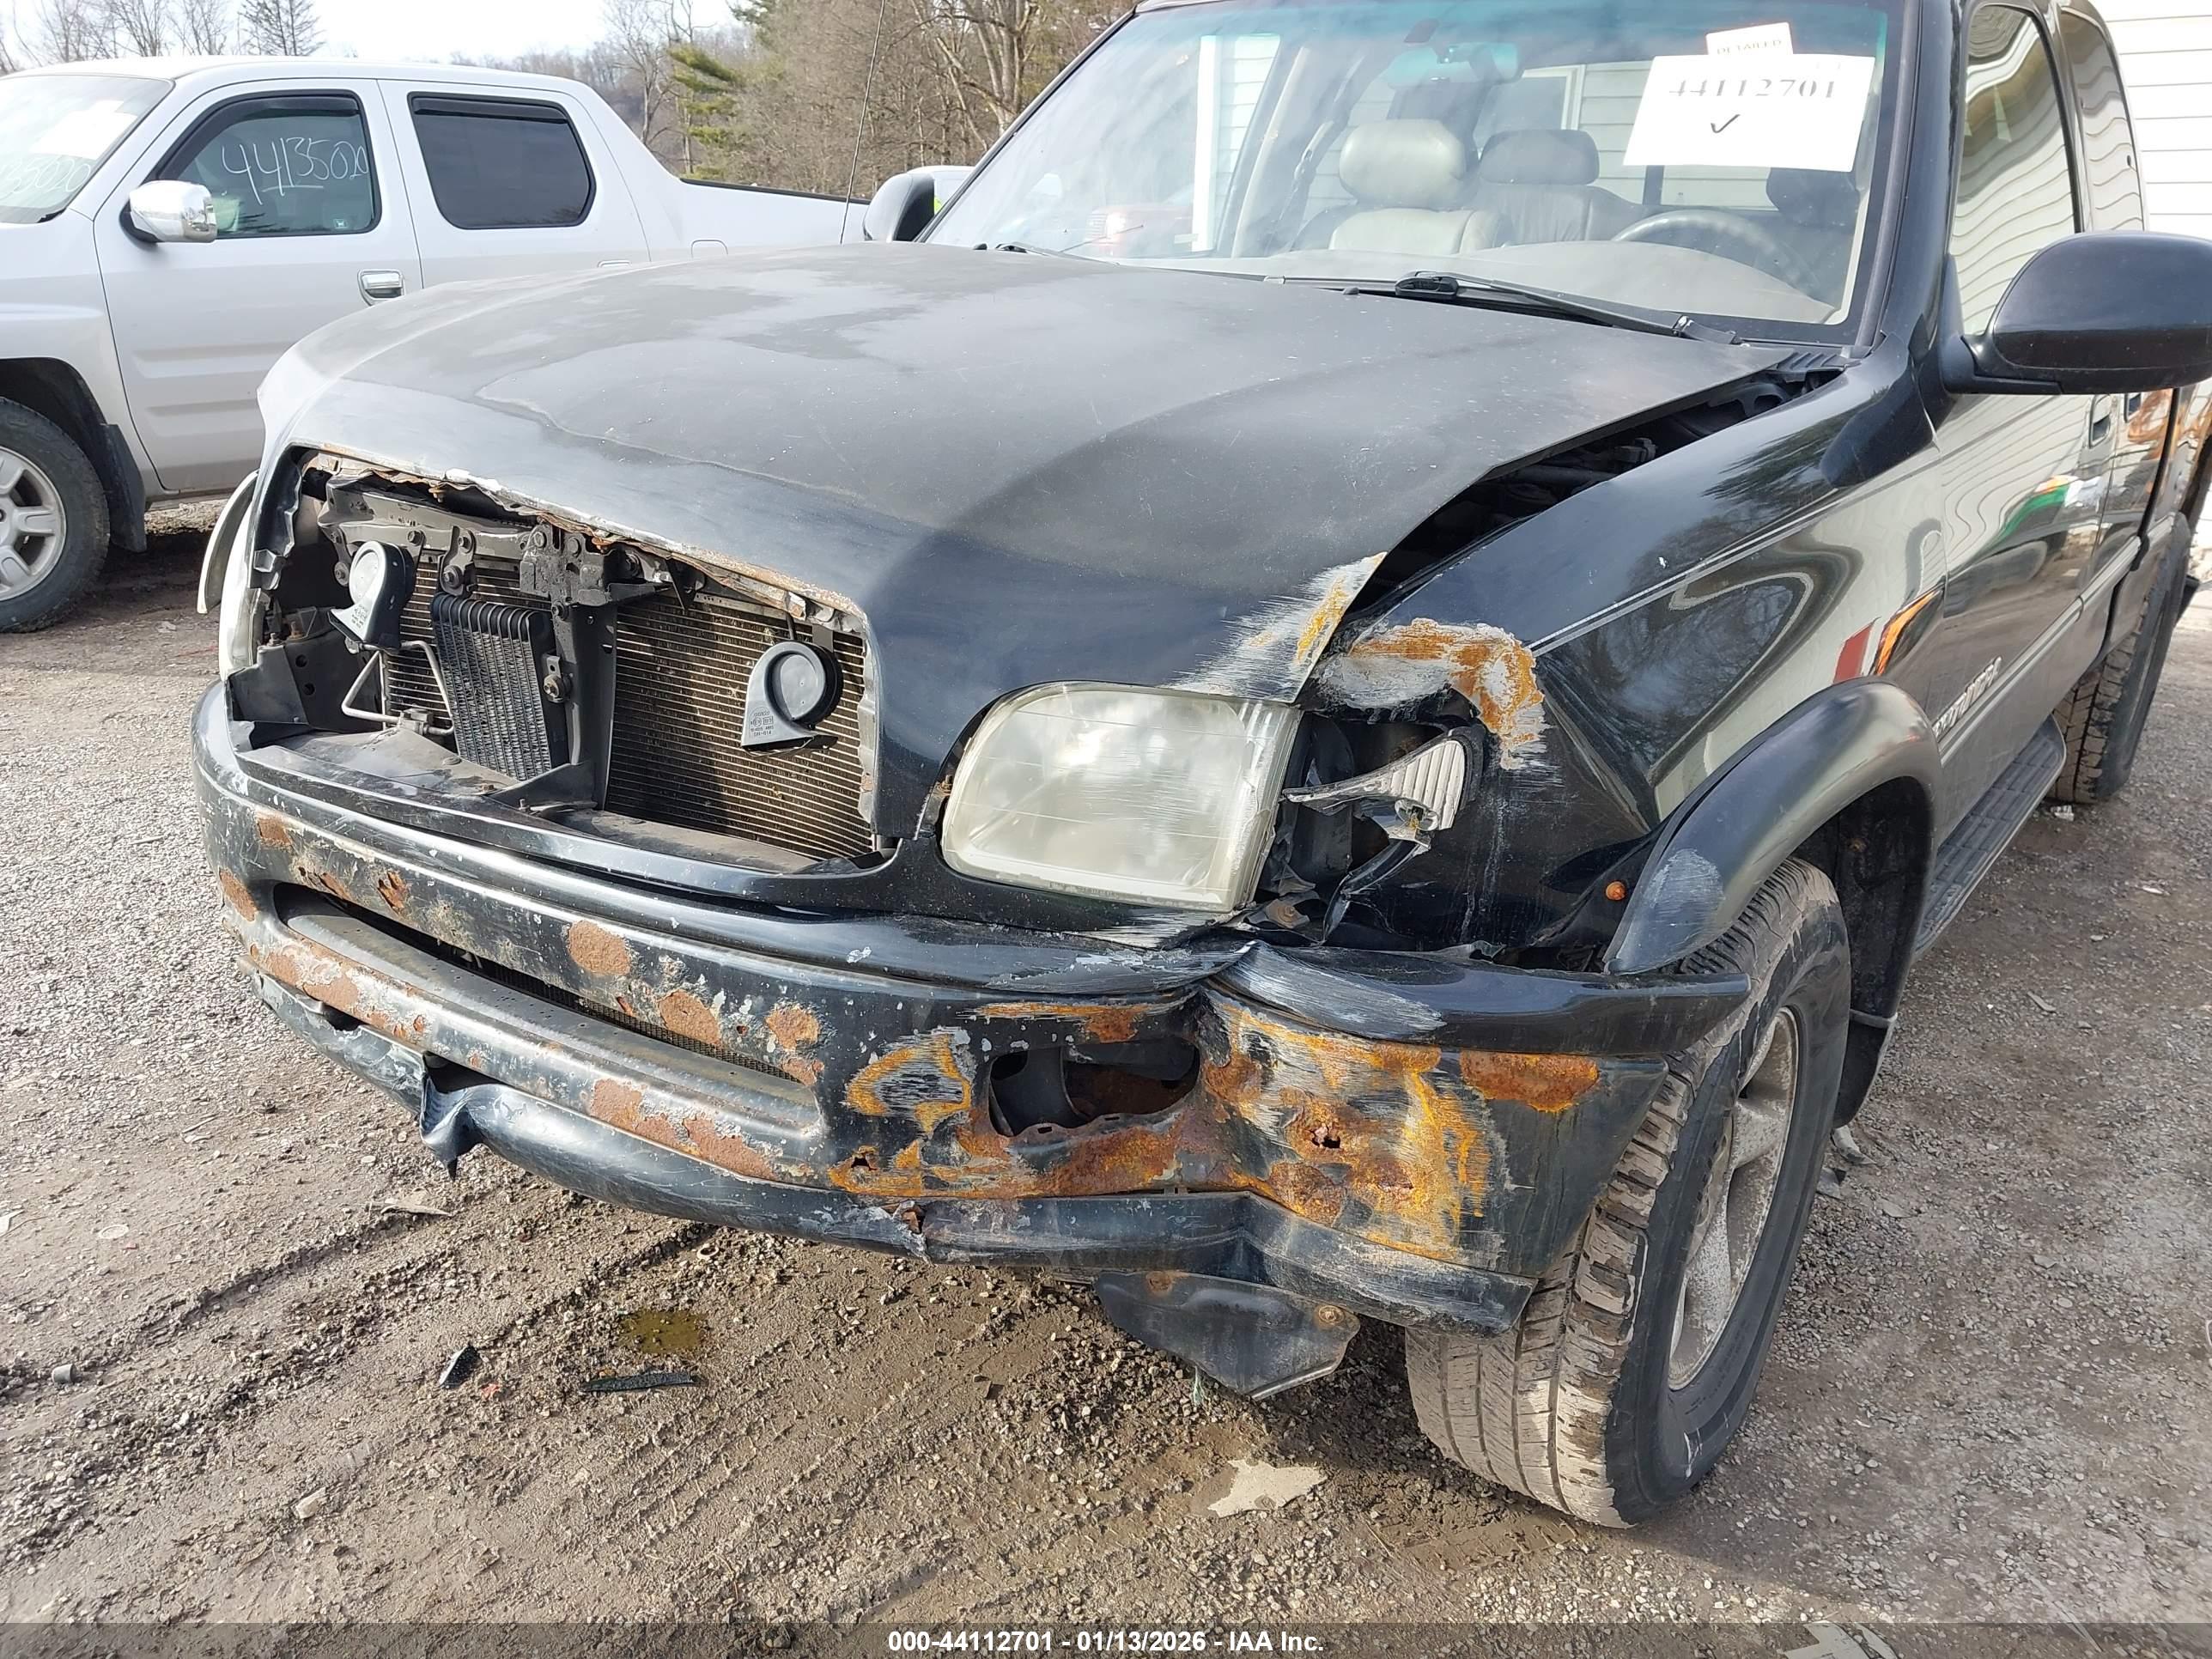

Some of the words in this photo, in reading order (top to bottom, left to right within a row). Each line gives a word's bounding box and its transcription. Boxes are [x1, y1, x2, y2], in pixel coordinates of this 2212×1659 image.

[1668, 78, 1836, 99] 44112701
[0, 155, 92, 201] 35020
[222, 137, 369, 206] 44135020
